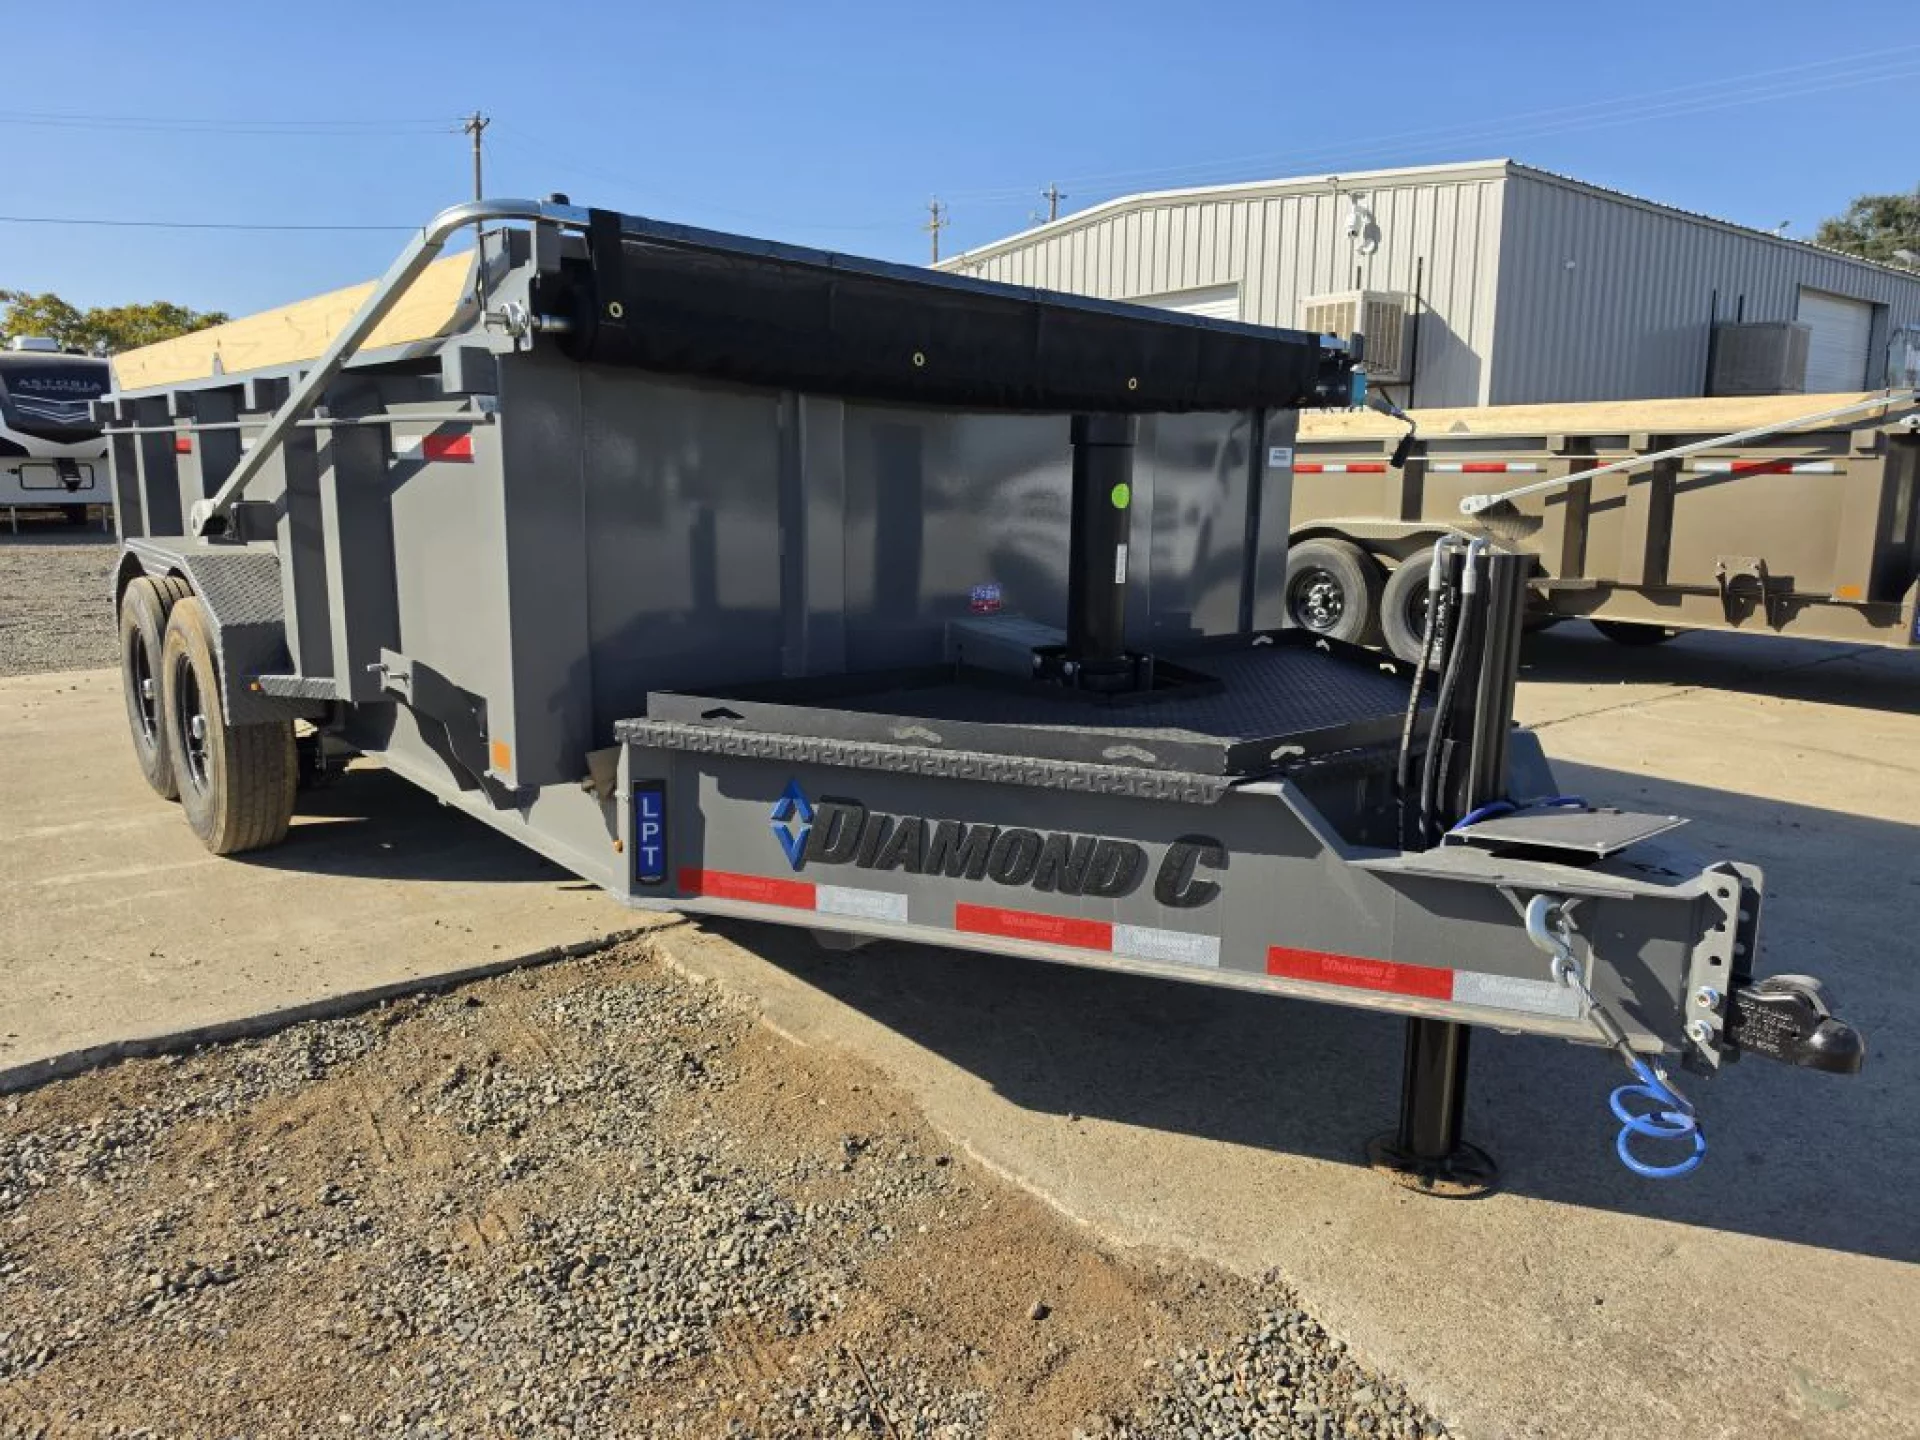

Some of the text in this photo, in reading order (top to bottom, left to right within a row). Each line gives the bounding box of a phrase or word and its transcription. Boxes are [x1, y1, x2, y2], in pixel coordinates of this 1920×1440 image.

[641, 796, 660, 867] LPT
[804, 795, 1230, 908] DIAMOND C
